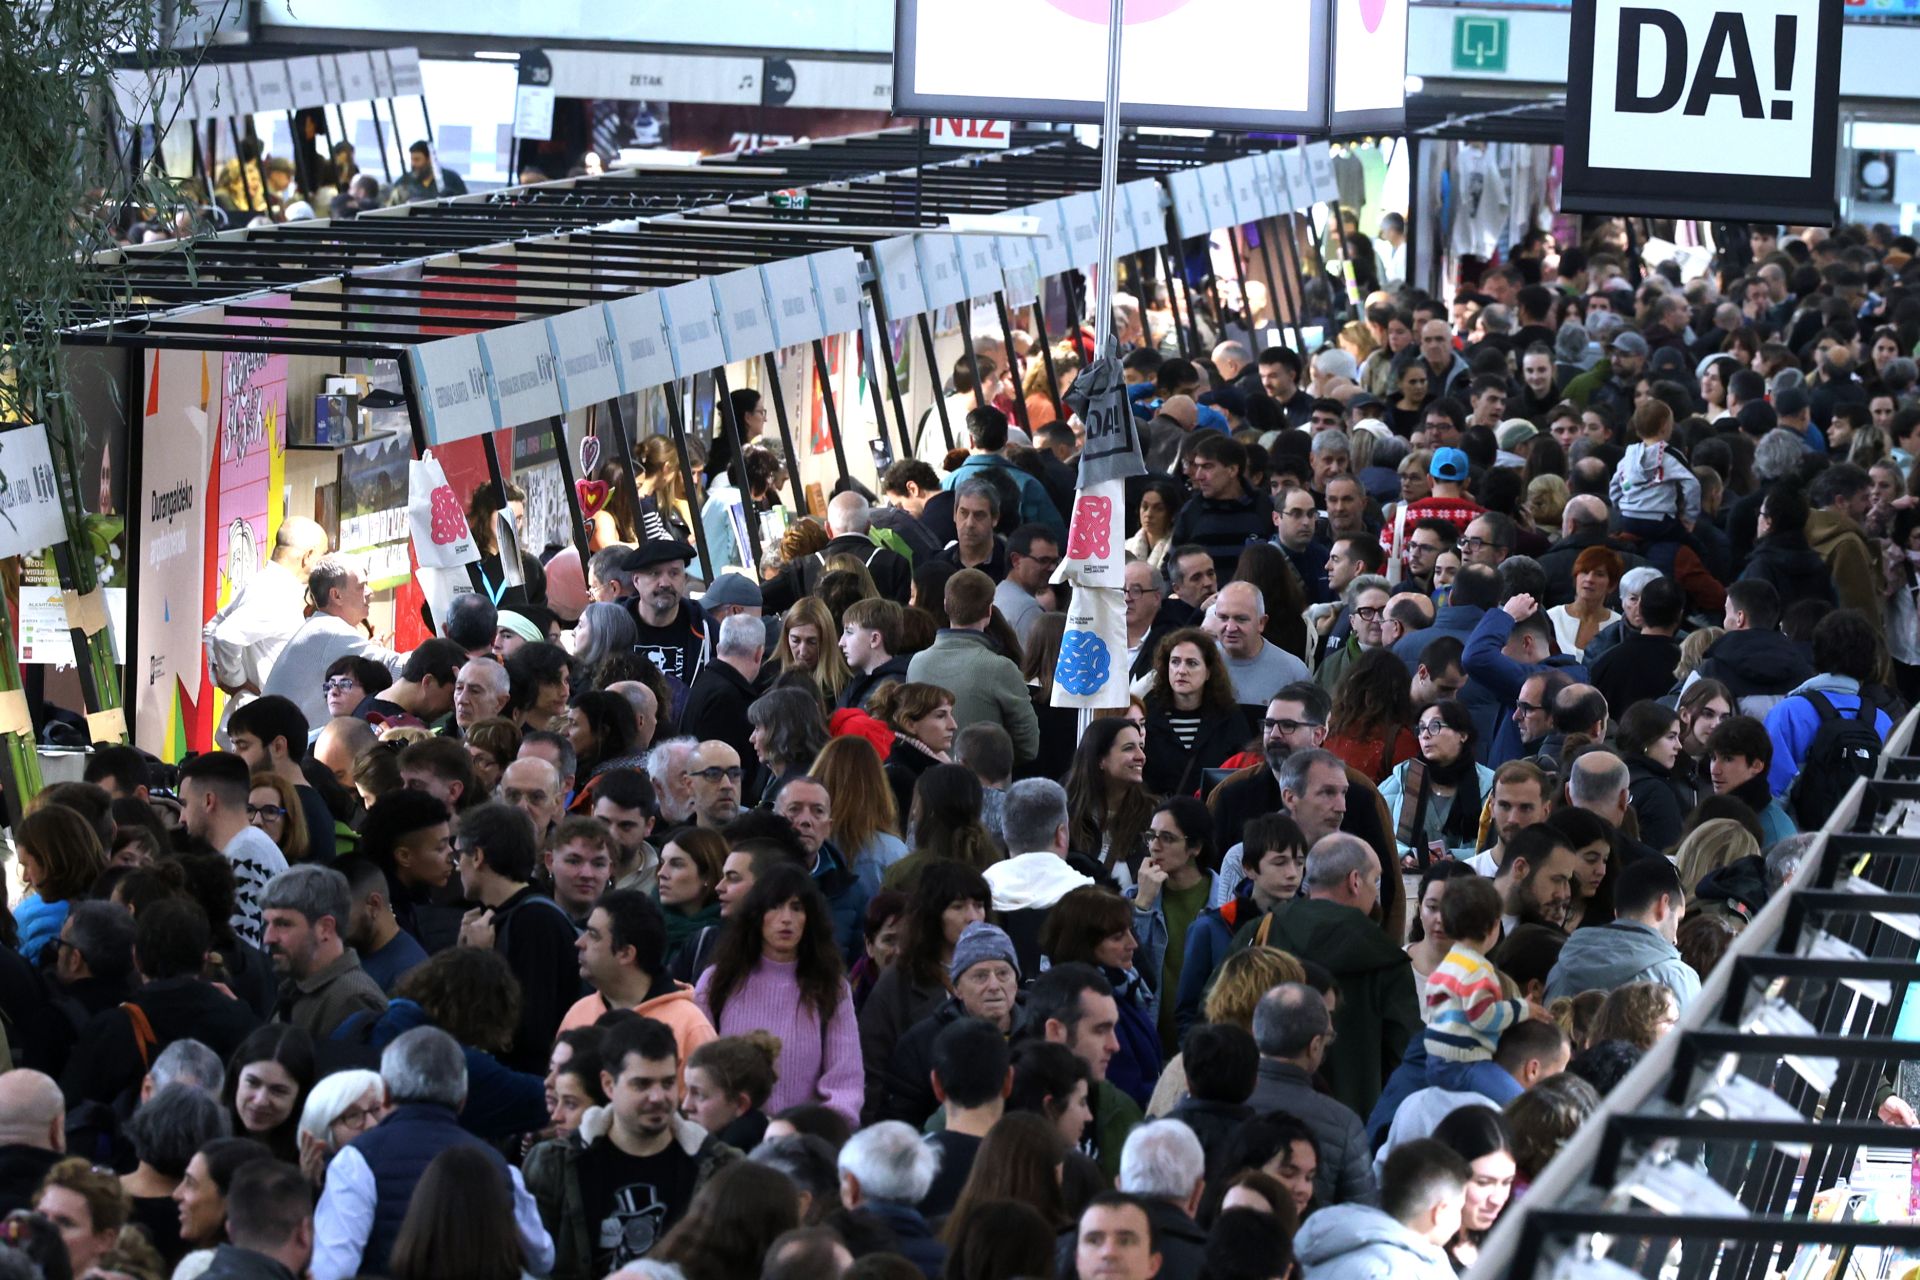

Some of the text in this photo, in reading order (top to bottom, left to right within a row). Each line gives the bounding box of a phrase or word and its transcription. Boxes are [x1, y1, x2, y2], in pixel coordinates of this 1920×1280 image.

[1615, 7, 1797, 120] DA!
[873, 85, 891, 97] ZET
[1086, 405, 1121, 440] DA!
[151, 478, 193, 525] Durangaldeko
